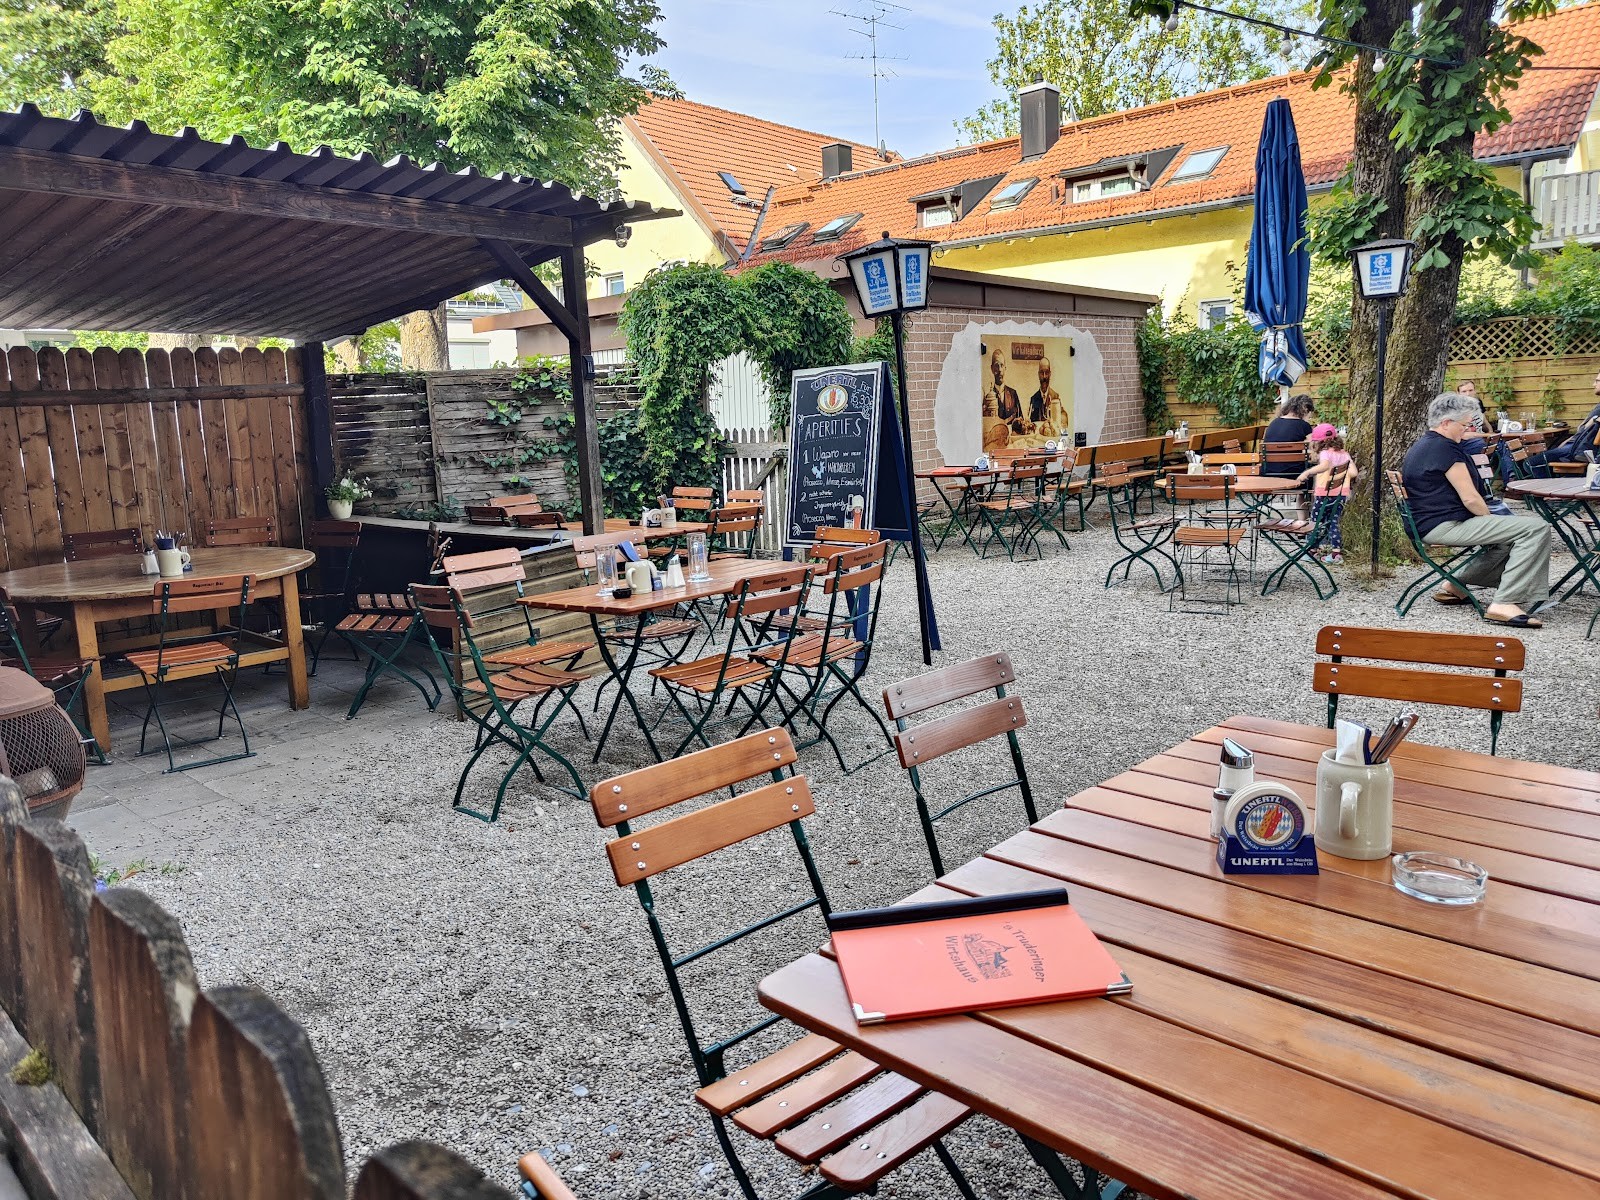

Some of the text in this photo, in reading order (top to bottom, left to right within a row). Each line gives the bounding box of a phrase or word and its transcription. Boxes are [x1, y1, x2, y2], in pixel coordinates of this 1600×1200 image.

[811, 374, 857, 391] UNERTL
[804, 418, 862, 441] APERITIFS
[1242, 795, 1281, 814] UNERTL
[1230, 857, 1285, 866] UNERTL
[945, 935, 979, 984] Wirtshaus
[1013, 929, 1045, 983] Truderinger
